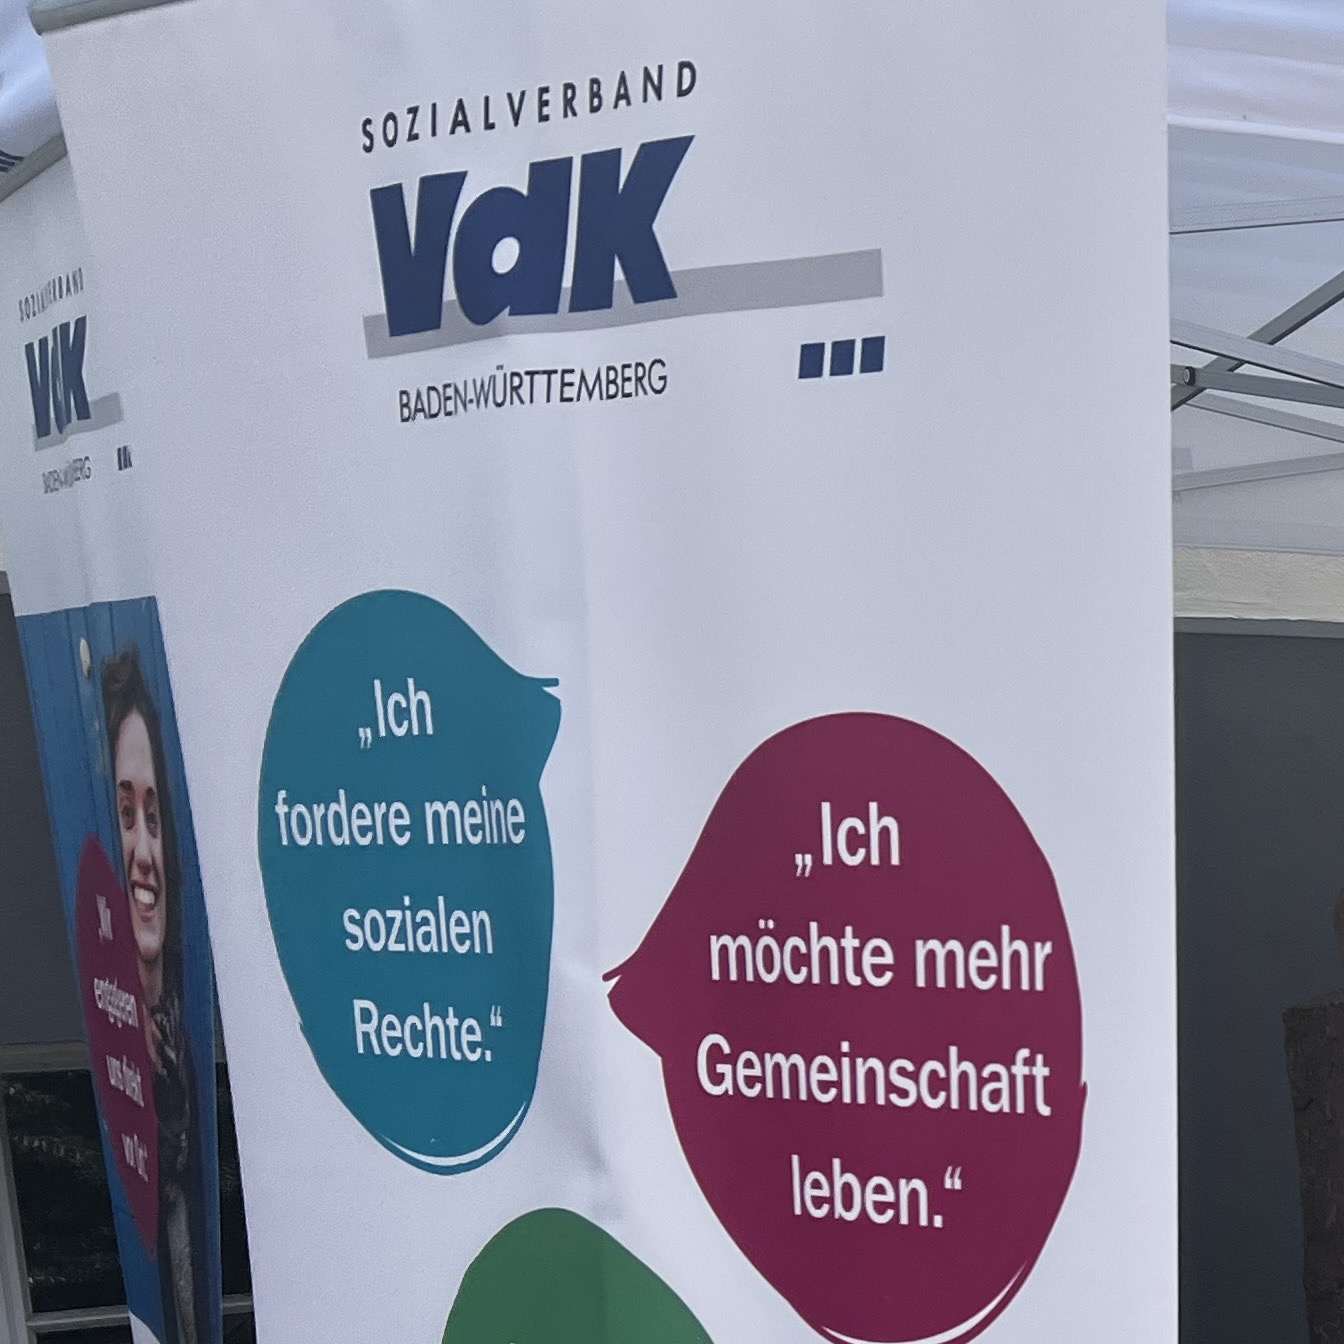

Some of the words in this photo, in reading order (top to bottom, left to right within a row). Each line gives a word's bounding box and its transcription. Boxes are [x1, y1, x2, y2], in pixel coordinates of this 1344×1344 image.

[361, 60, 699, 153] SOZIALVERBAND
[369, 134, 695, 338] VdK
[398, 358, 668, 422] BADEN-WÜRTTEMBERG
[359, 677, 434, 751] „Ich
[276, 790, 411, 848] fordere
[425, 785, 526, 845] meine
[794, 801, 901, 878] „Ich
[343, 897, 493, 954] sozialen
[709, 919, 895, 988] möchte
[914, 925, 1052, 994] mehr
[353, 999, 504, 1065] Rechte.“
[696, 1033, 1052, 1118] Gemeinschaft
[792, 1155, 964, 1230] leben.“
